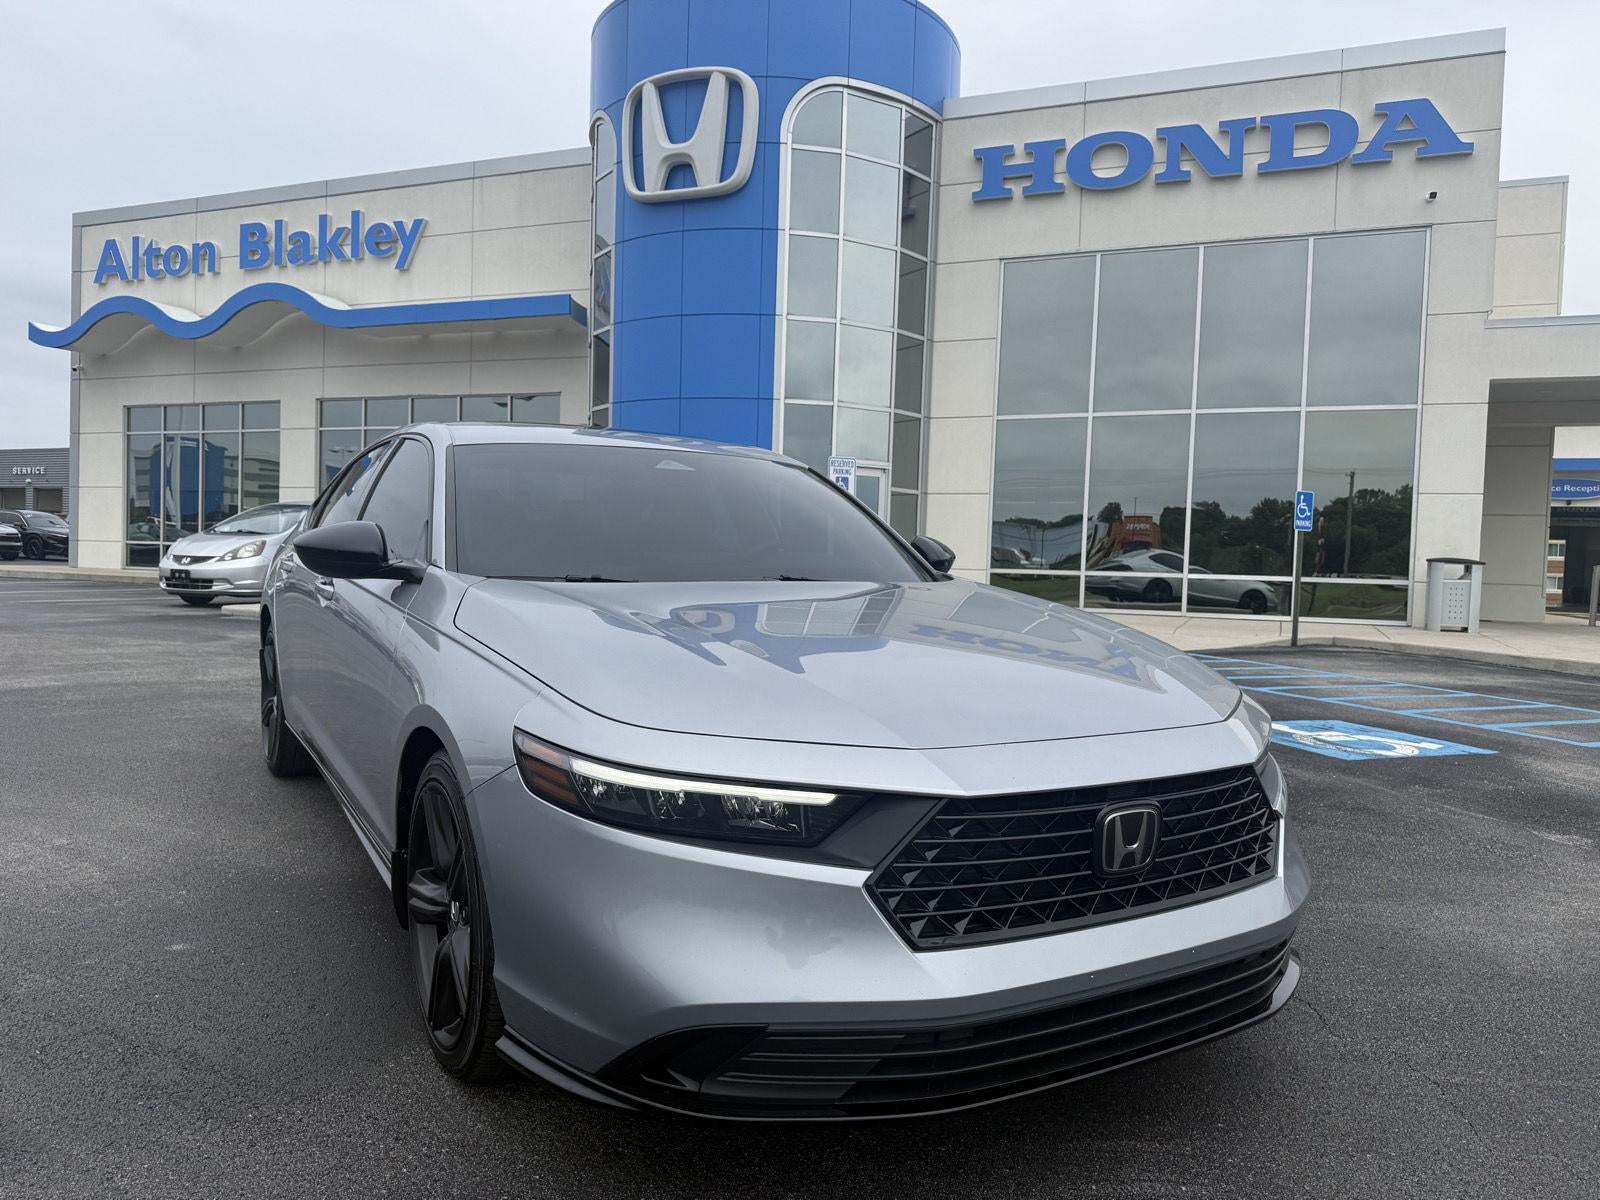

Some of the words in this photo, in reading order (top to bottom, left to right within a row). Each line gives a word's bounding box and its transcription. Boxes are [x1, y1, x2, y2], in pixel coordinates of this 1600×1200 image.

[971, 97, 1475, 202] HONDA
[94, 236, 220, 286] Alton
[239, 209, 428, 272] Blakley
[830, 459, 854, 468] RESERVED
[12, 466, 46, 474] SERVICE
[832, 468, 852, 476] PARKING
